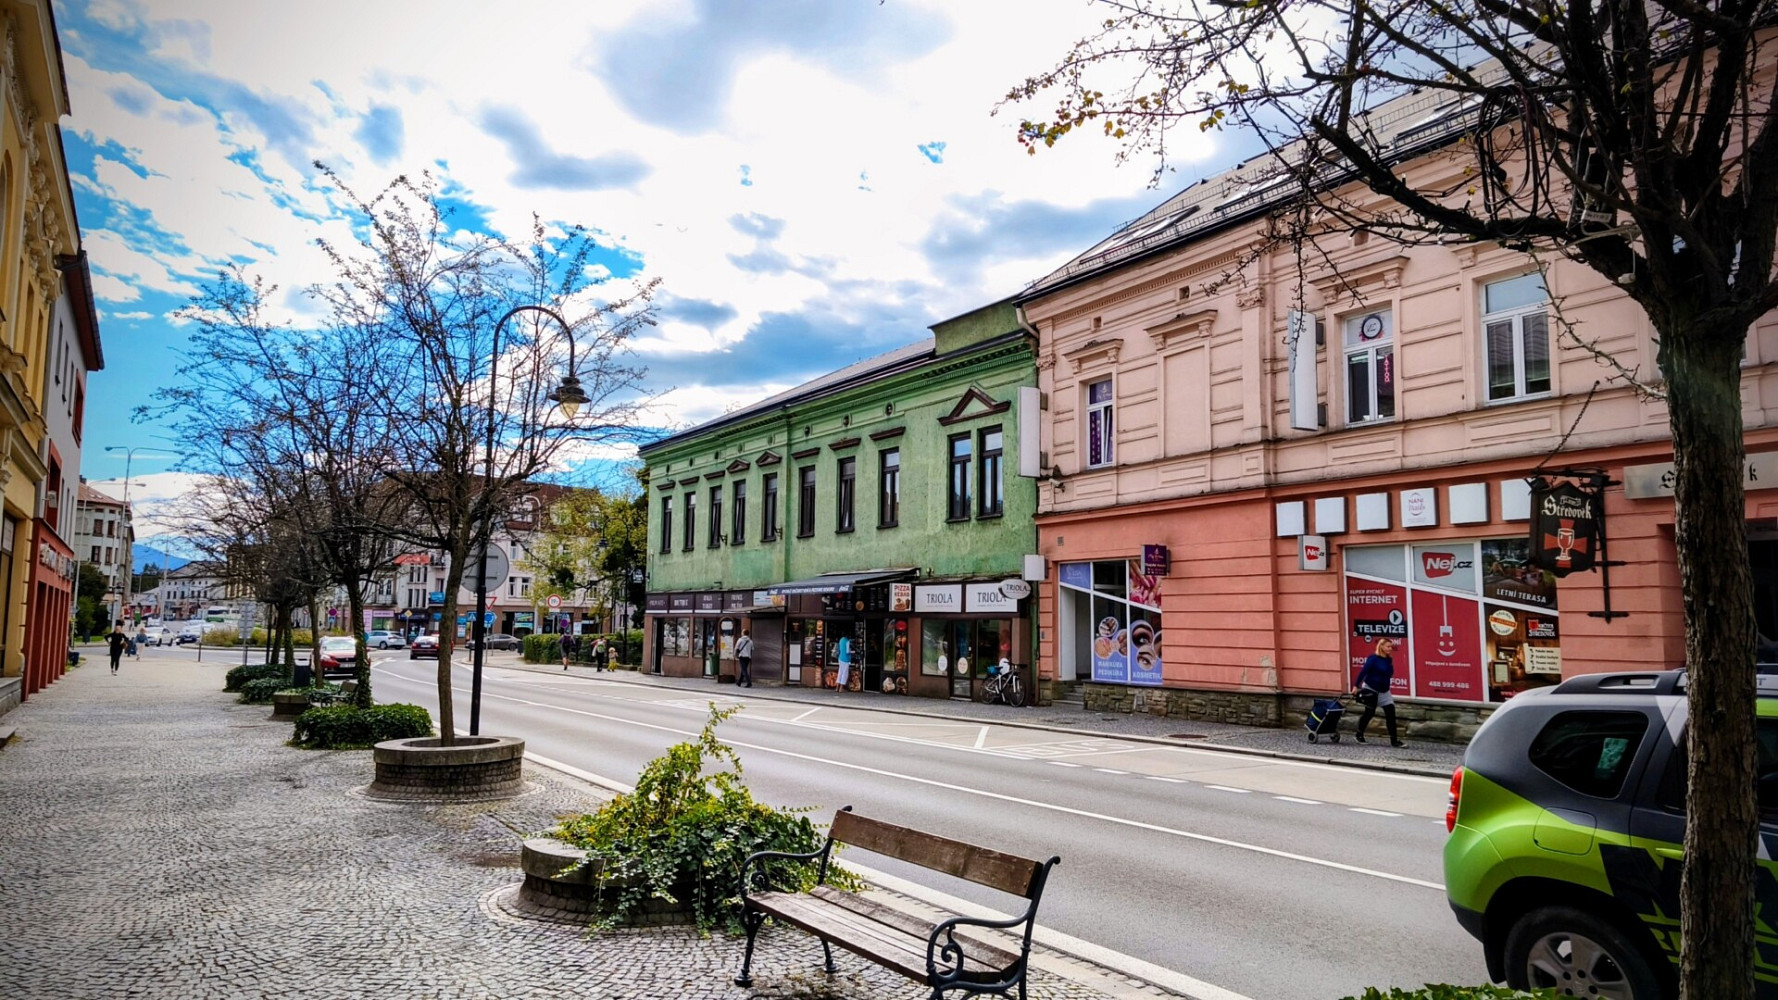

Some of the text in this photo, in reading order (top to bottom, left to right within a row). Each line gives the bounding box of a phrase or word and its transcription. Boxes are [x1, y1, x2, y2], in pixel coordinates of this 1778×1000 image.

[1426, 556, 1473, 572] Nej.cz
[1006, 584, 1027, 592] TRIOLA
[926, 593, 953, 604] TRIOLA
[1349, 595, 1398, 604] INTERNET
[1496, 588, 1547, 603] LETNÍ TERASA
[1357, 624, 1405, 634] TELEVIZE
[1132, 671, 1162, 680] KOSMETIK
